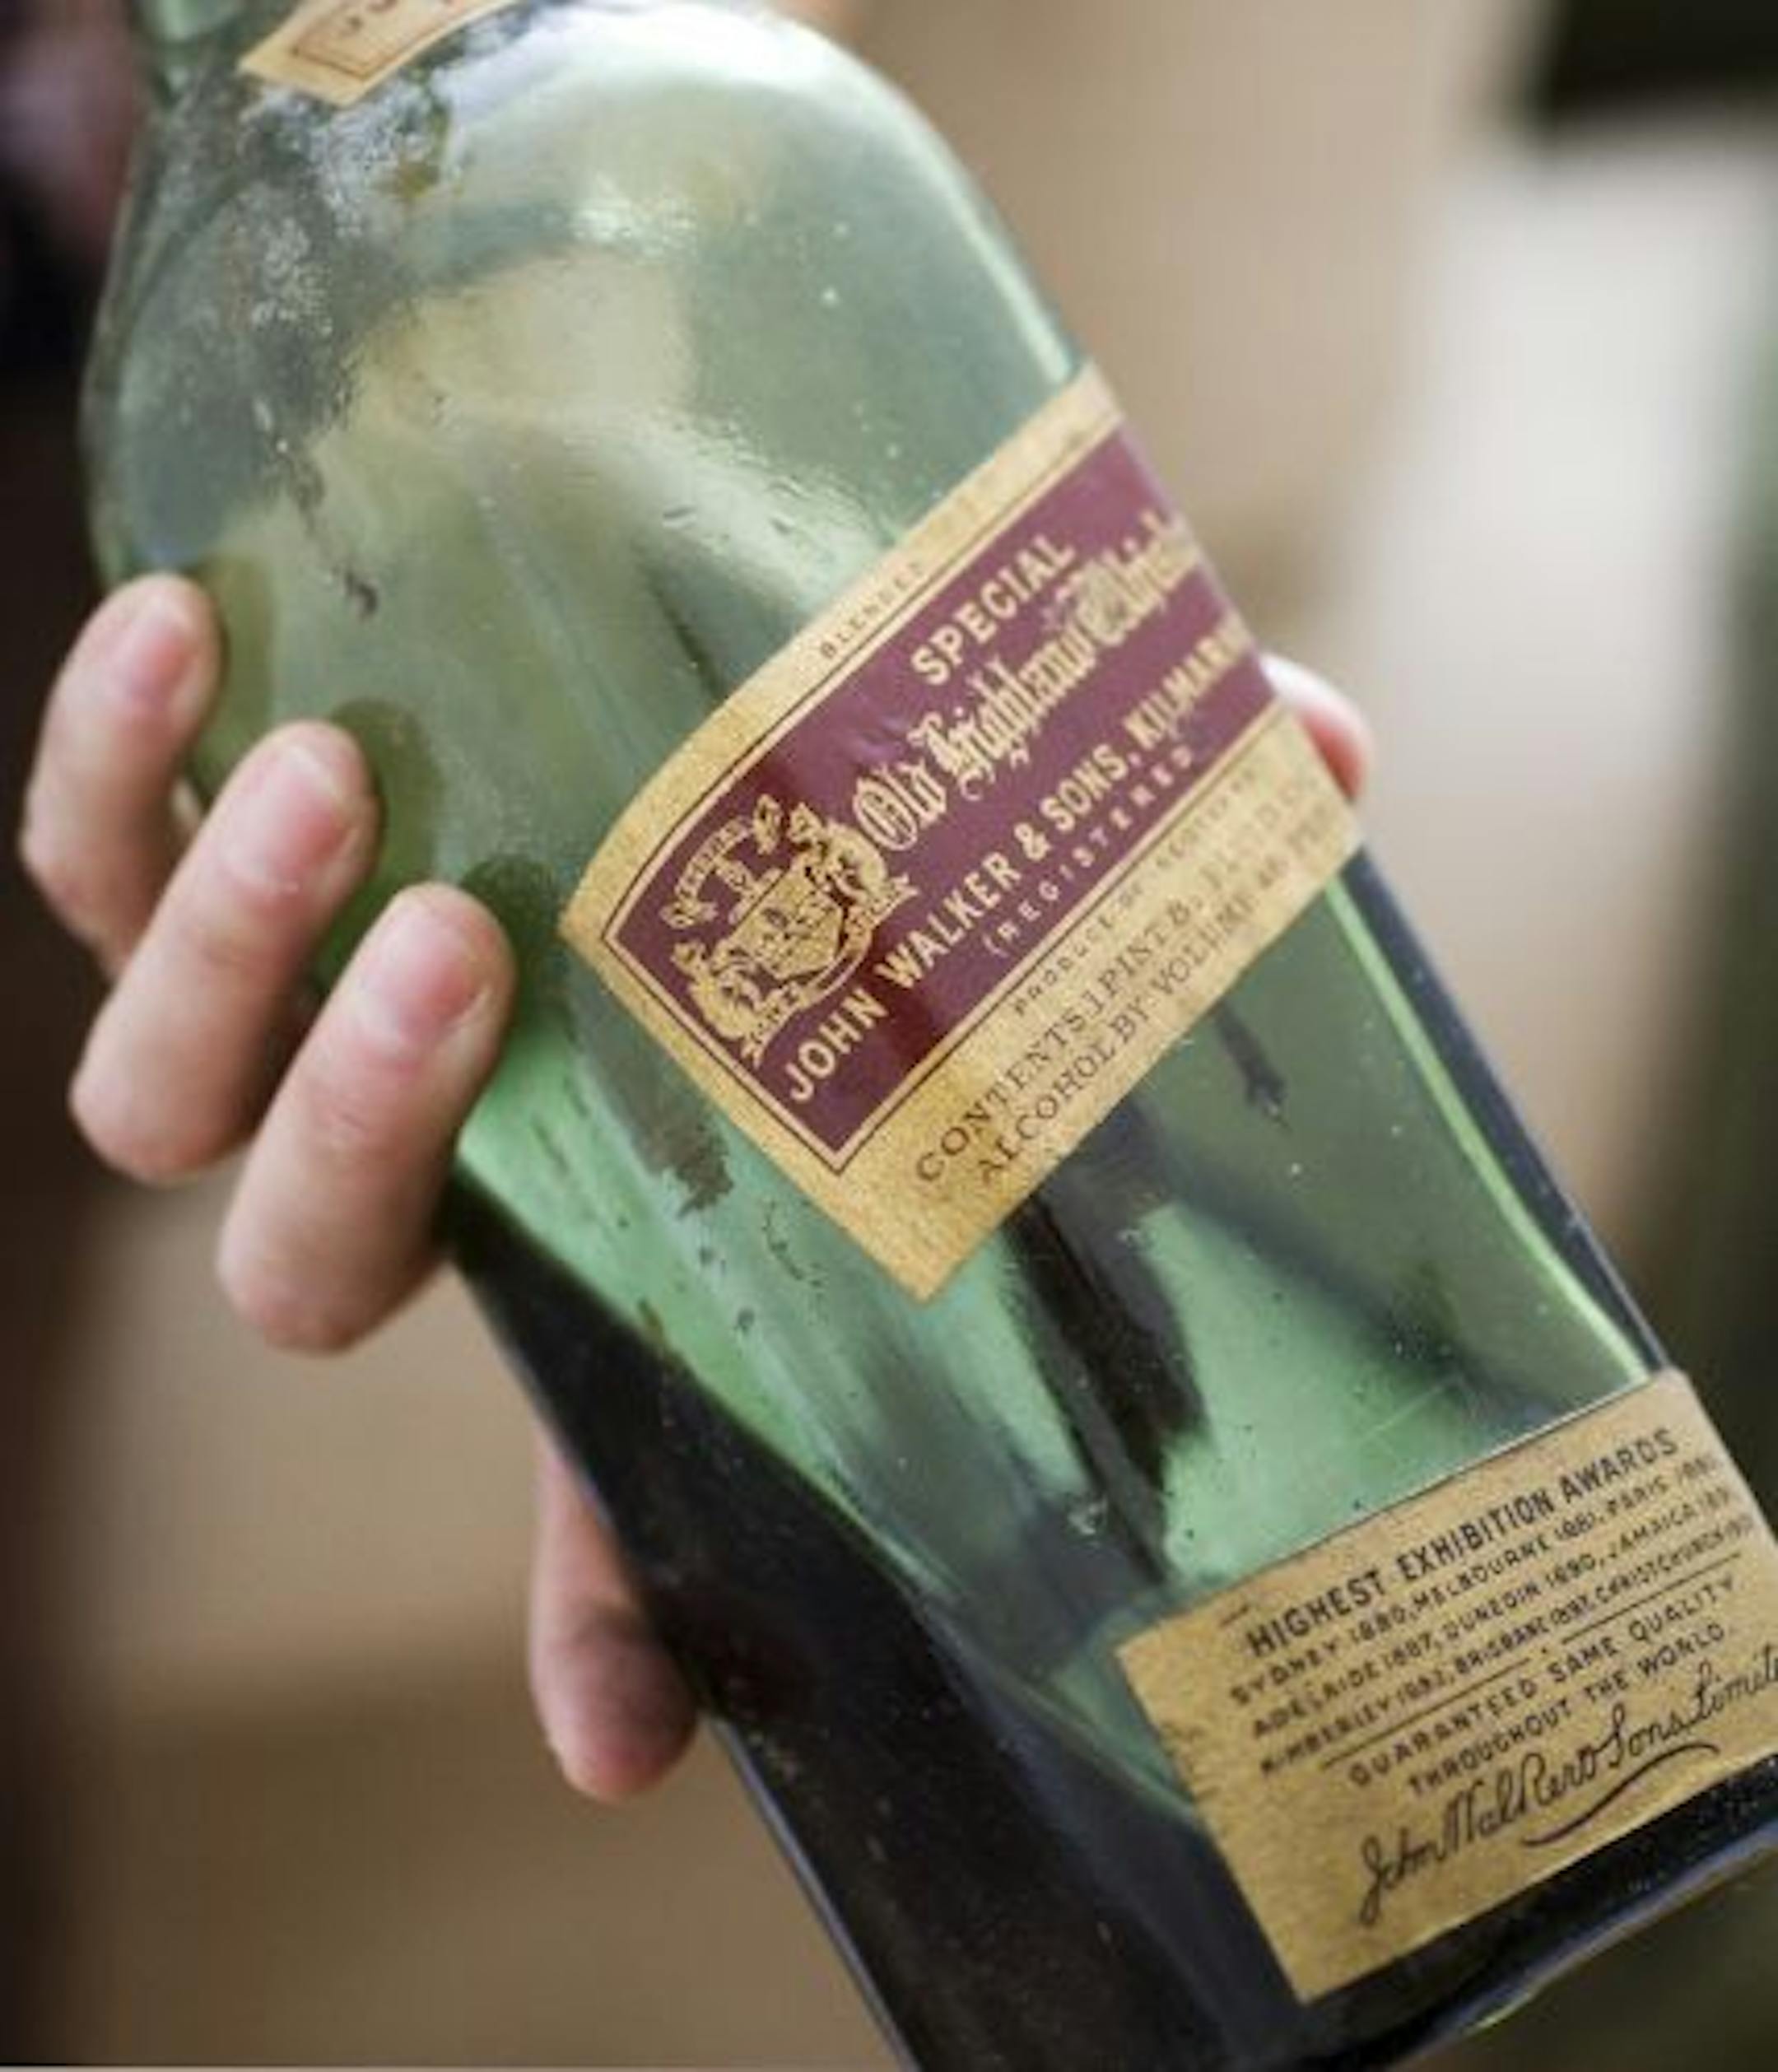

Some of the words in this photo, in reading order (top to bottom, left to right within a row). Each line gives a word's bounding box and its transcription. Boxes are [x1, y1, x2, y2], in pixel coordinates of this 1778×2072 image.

[910, 534, 1076, 686] SPECIAL
[851, 758, 948, 851] Old
[906, 609, 1097, 803] Highland
[783, 987, 890, 1104] JOHN
[873, 852, 1022, 989] WALKER
[1013, 822, 1052, 861] &
[915, 1010, 1089, 1181] CONTENTS
[978, 1036, 1116, 1183] ALCOHOL
[1110, 994, 1153, 1045] BY
[1231, 1636, 1338, 1706] SYDNEY
[1413, 1533, 1550, 1614] MELBOURNE
[1605, 1475, 1669, 1516] PARIS
[1244, 1567, 1386, 1658] HIGHEST
[1395, 1488, 1555, 1582] EXHIBITION
[1558, 1428, 1679, 1503] AWARDS
[1254, 1658, 1381, 1739] ADELAIDE
[1441, 1580, 1542, 1642] DUNEDIN
[1606, 1501, 1697, 1561] JAMAICA
[1348, 1678, 1538, 1787] GUARANTEED
[1547, 1636, 1620, 1685] SAME
[1628, 1574, 1733, 1646] QUALITY
[1407, 1697, 1573, 1797] THROUGHOUT
[1583, 1669, 1630, 1704] THE
[1453, 1615, 1551, 1676] BRISBANE
[1357, 1825, 1447, 1930] John
